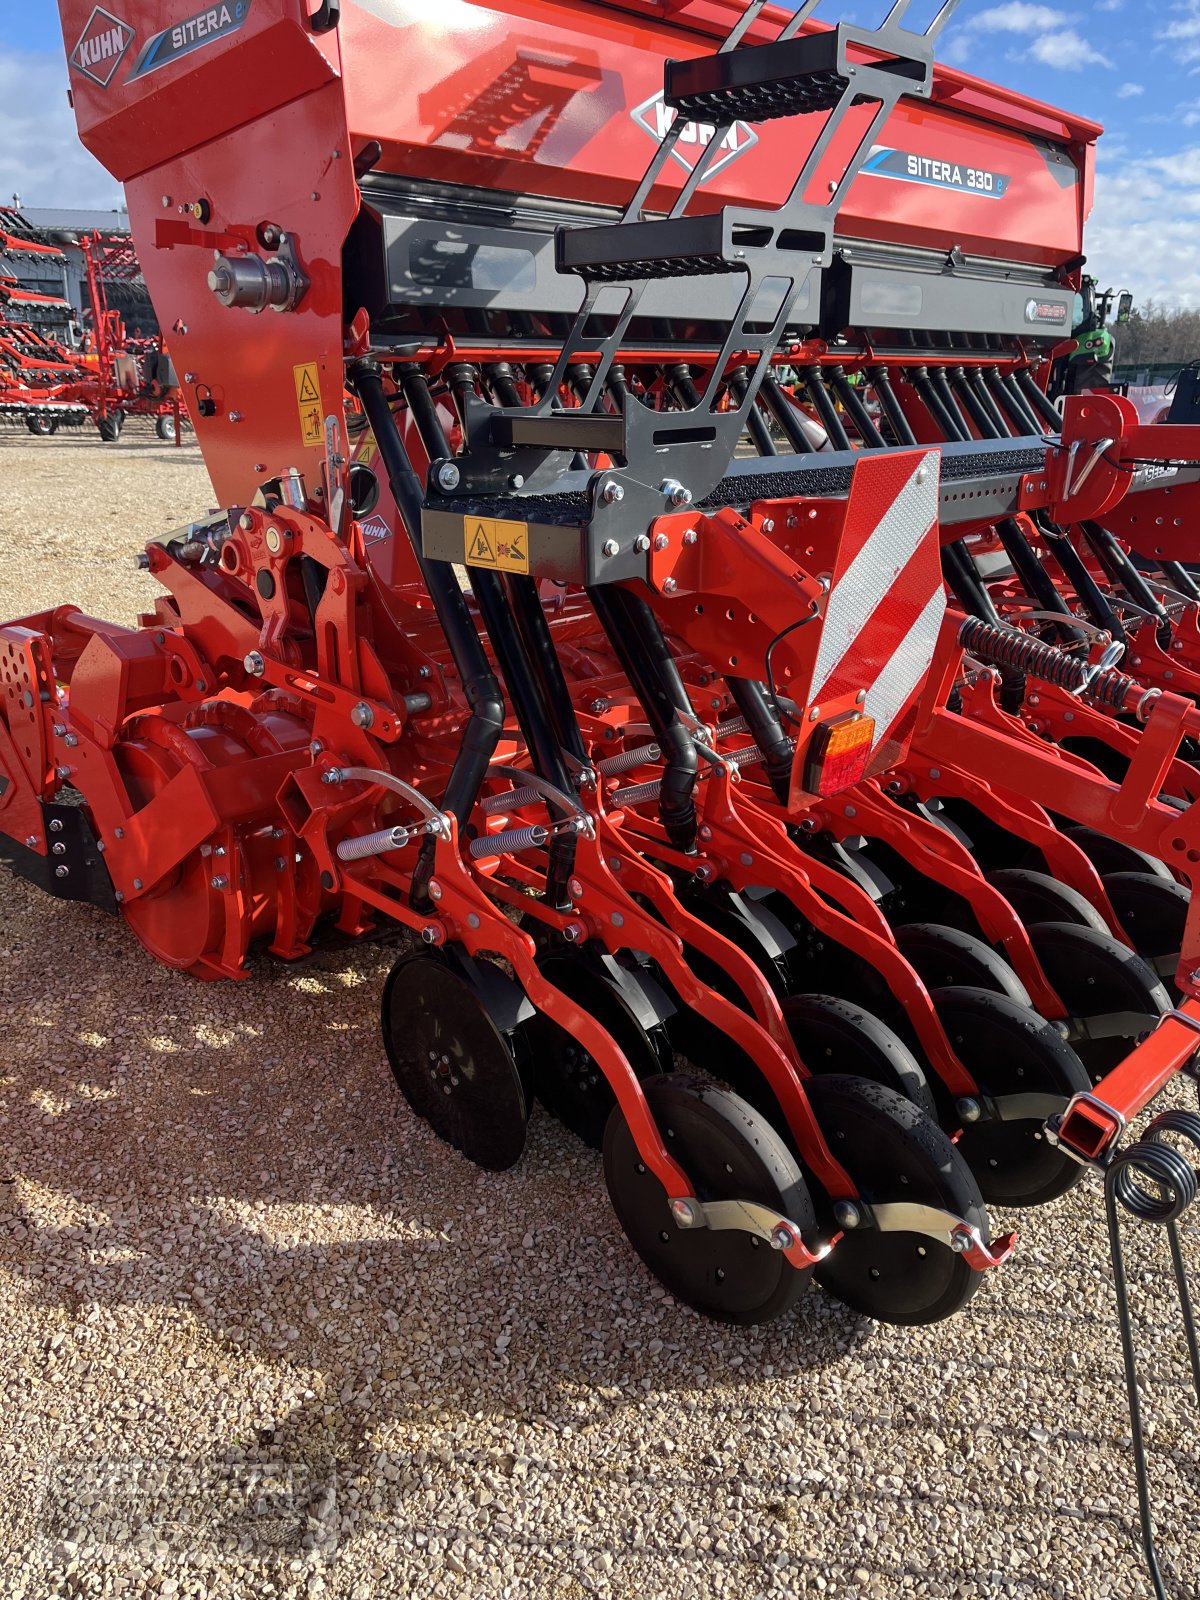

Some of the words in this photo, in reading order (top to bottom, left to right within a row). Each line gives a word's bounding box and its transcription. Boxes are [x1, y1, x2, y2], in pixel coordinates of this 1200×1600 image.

[79, 25, 124, 68] KUHN
[172, 5, 232, 49] SITERA
[235, 2, 243, 19] e
[907, 155, 962, 185] SITERA
[967, 168, 993, 191] 330
[997, 179, 1003, 192] e
